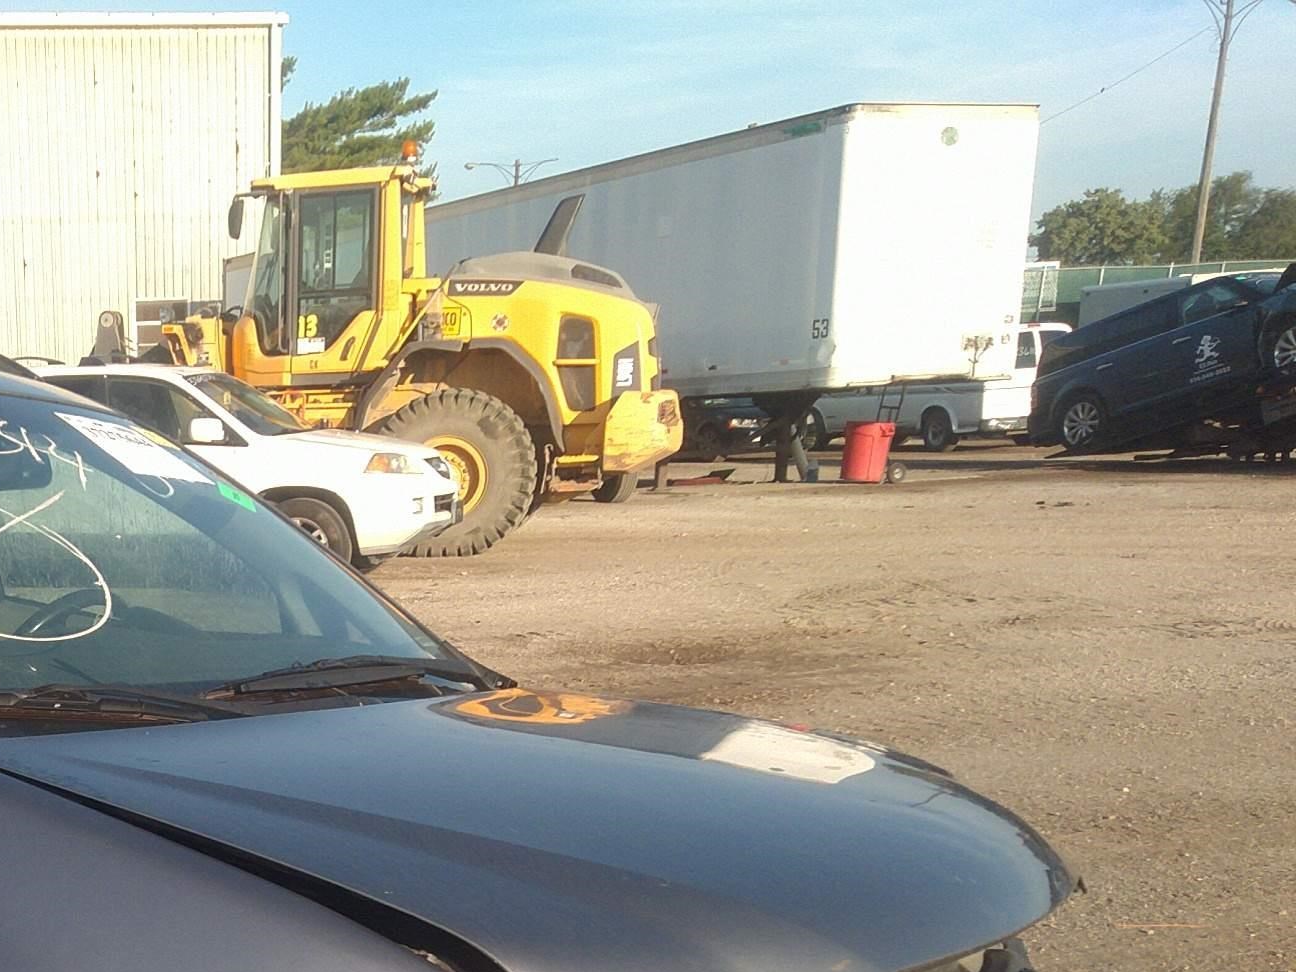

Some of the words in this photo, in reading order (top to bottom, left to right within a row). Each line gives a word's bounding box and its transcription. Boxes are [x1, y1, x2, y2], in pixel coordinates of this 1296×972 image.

[454, 283, 514, 293] VOLVO
[298, 313, 318, 338] 13
[812, 318, 829, 340] 53
